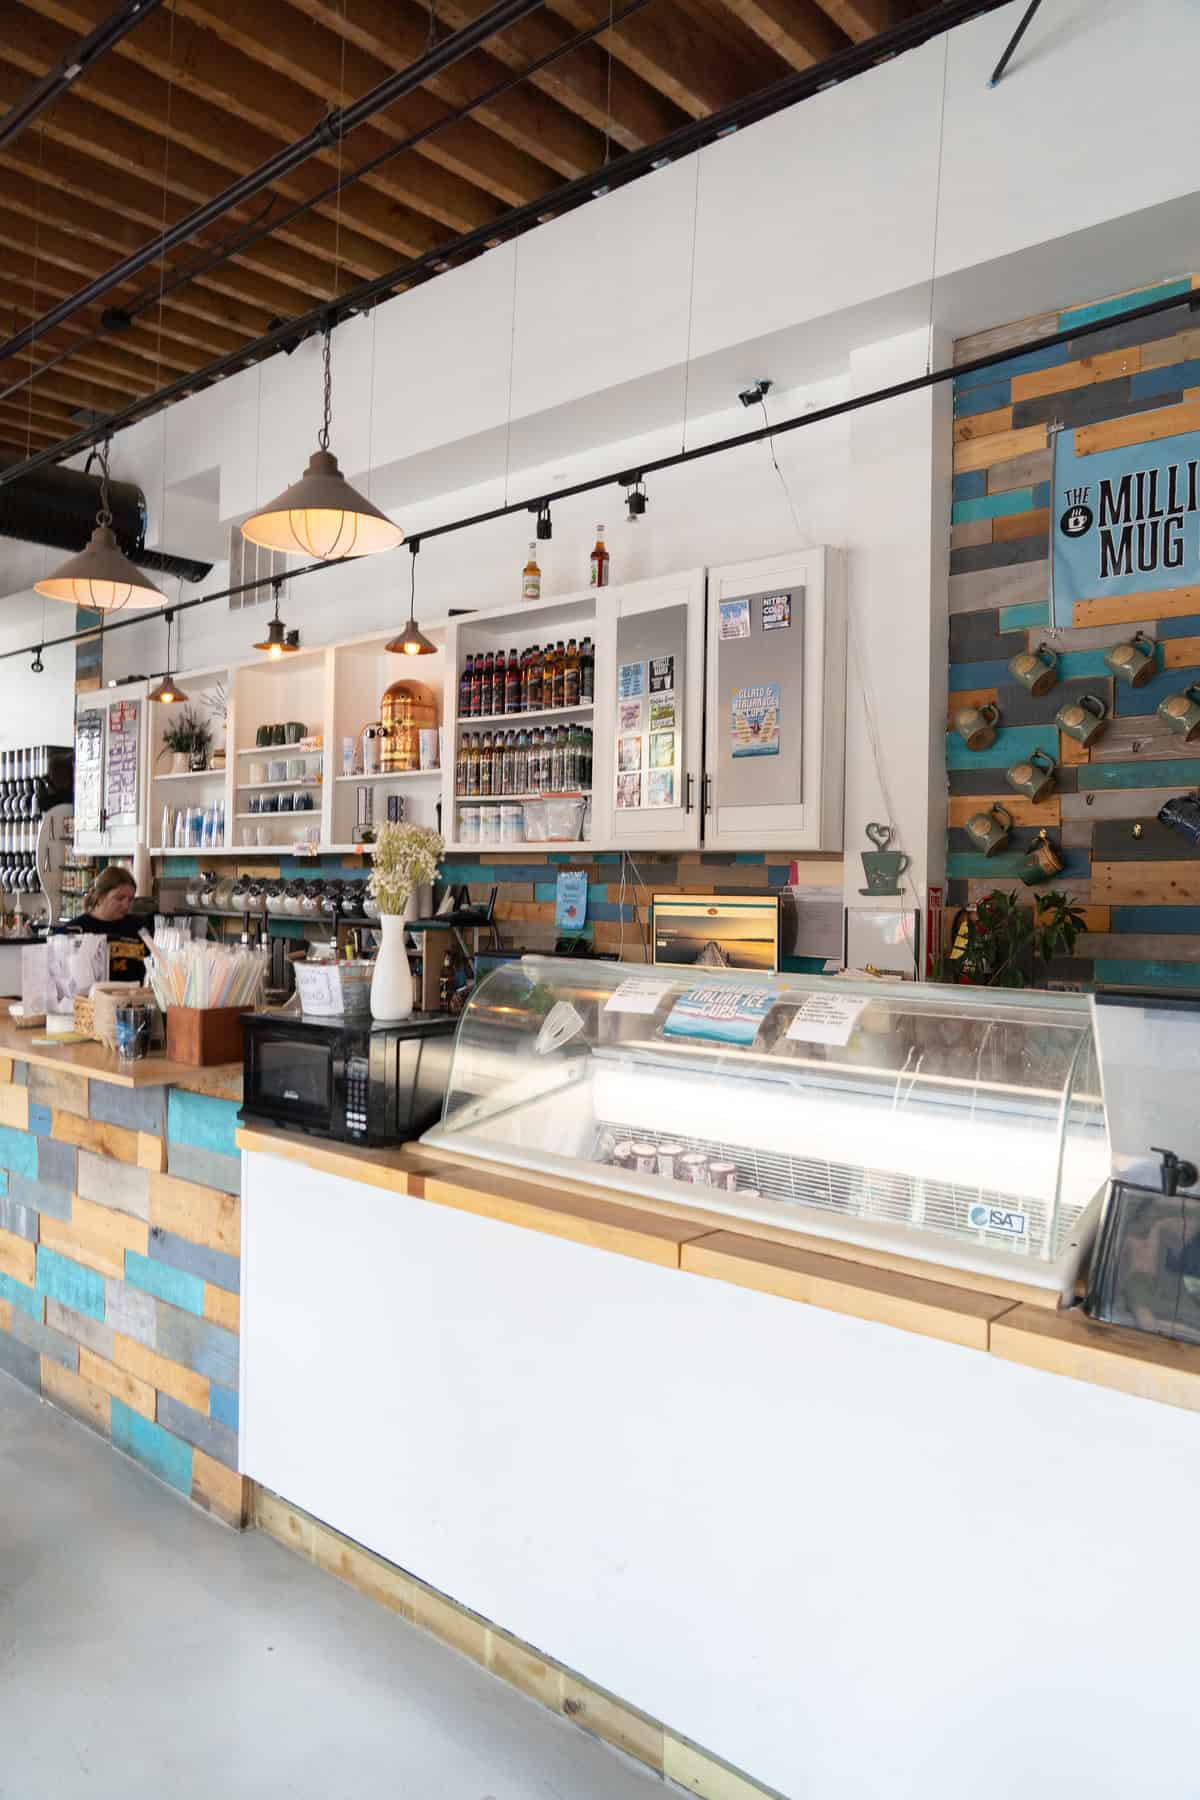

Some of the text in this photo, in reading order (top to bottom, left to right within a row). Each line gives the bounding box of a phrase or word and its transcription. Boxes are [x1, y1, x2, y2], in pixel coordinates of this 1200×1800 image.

[1064, 486, 1091, 506] THE
[1099, 515, 1184, 578] MUG
[989, 1209, 1013, 1227] ISA
